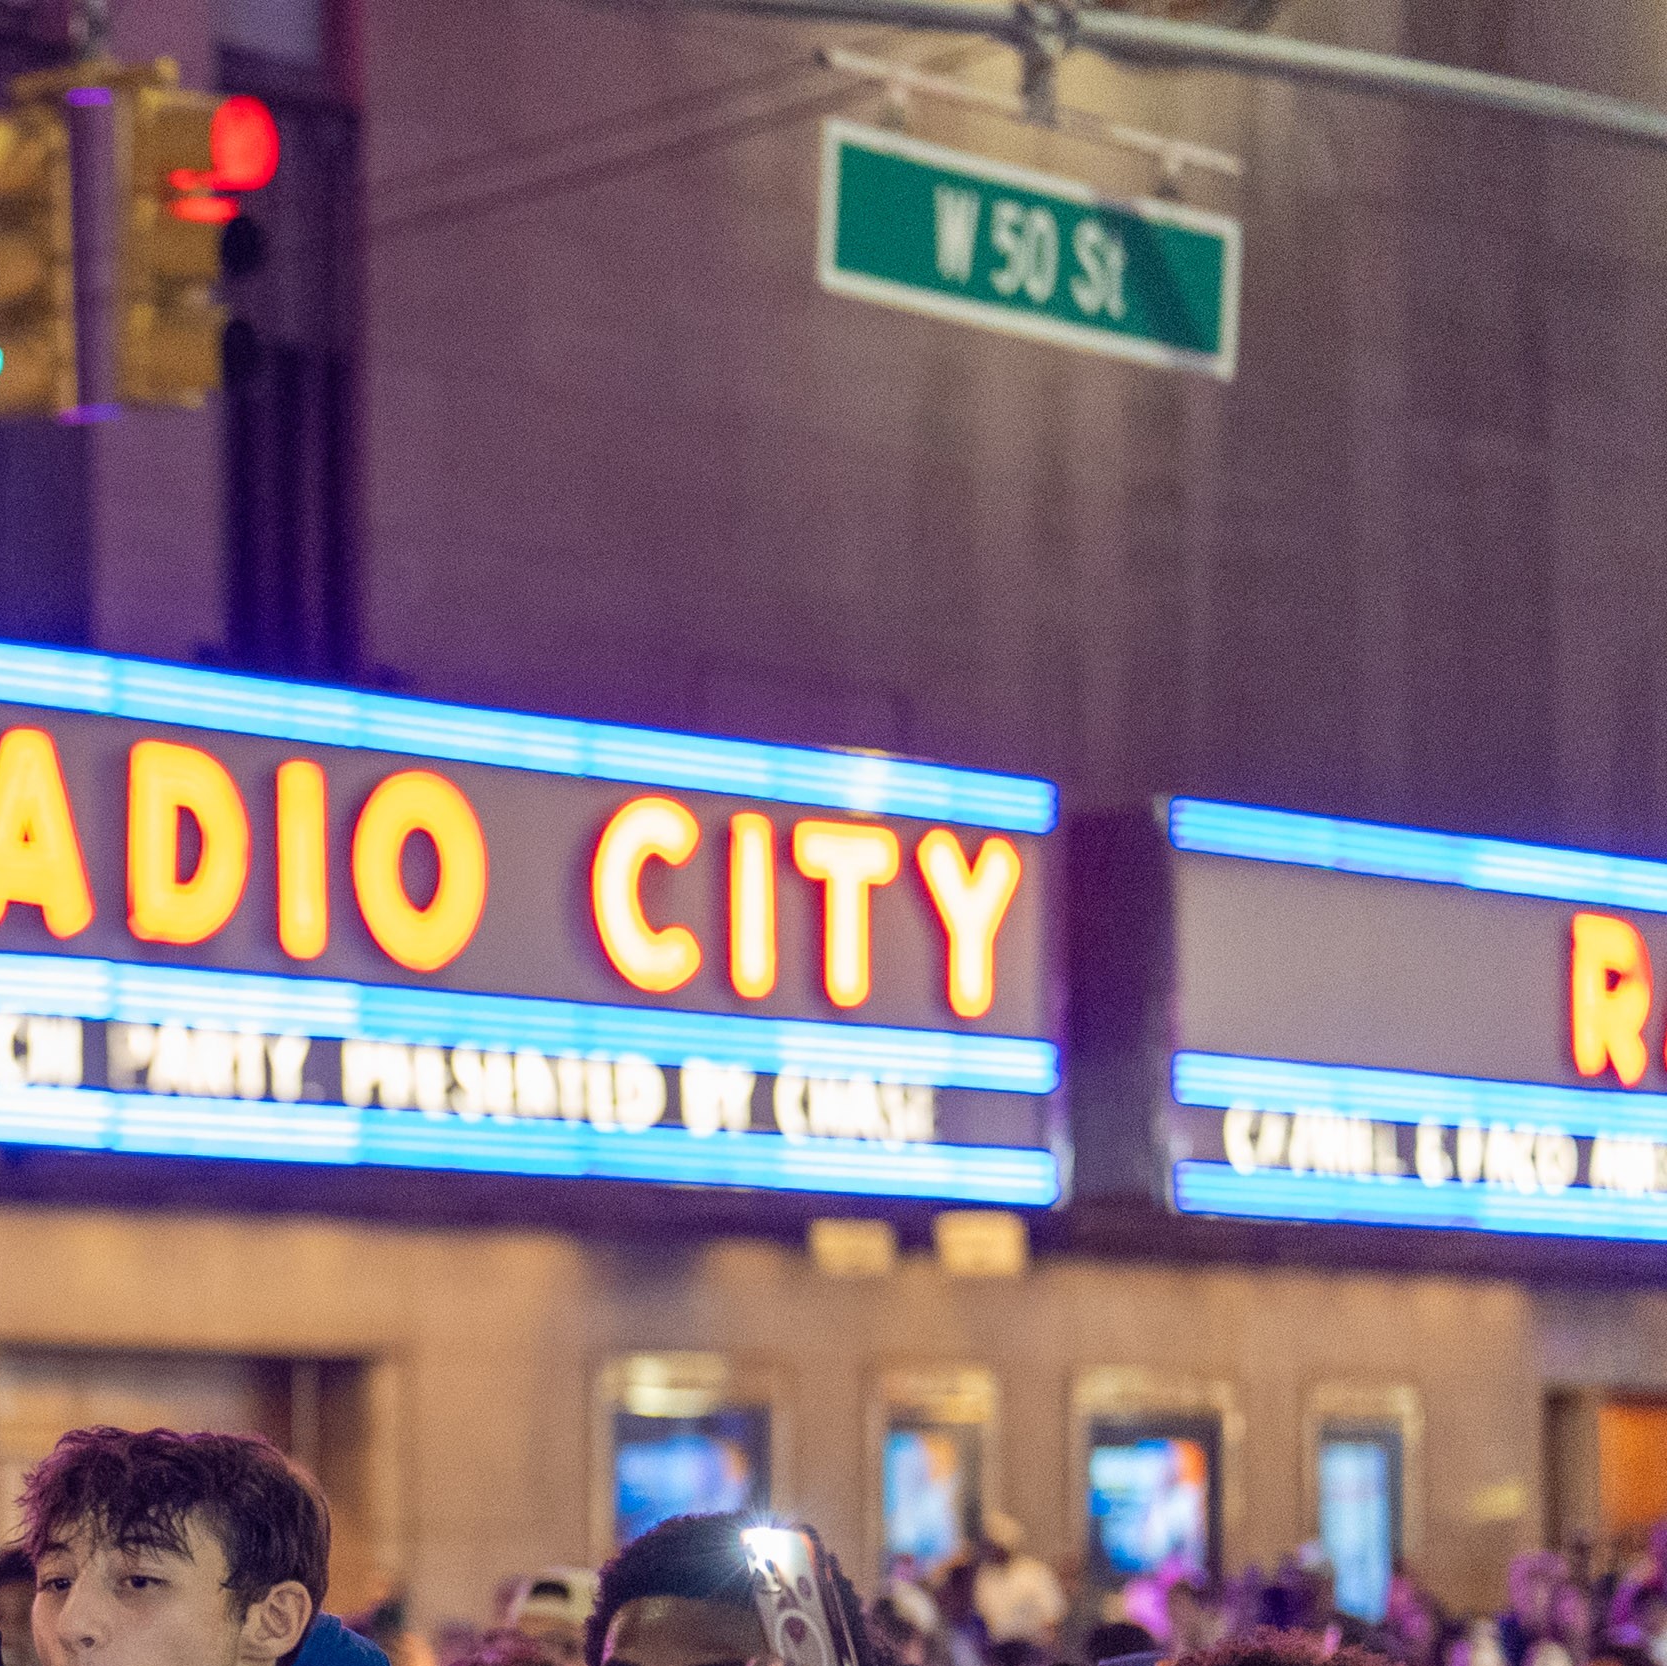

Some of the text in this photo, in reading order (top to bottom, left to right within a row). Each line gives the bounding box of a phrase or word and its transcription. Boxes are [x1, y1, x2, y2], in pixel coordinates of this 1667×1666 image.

[934, 184, 1126, 320] W 50 St
[592, 794, 1021, 1017] CITY
[1571, 911, 1667, 1088] R
[108, 1021, 310, 1103] PARTY
[341, 1036, 666, 1133] PRESENTED
[681, 1056, 756, 1137] BY
